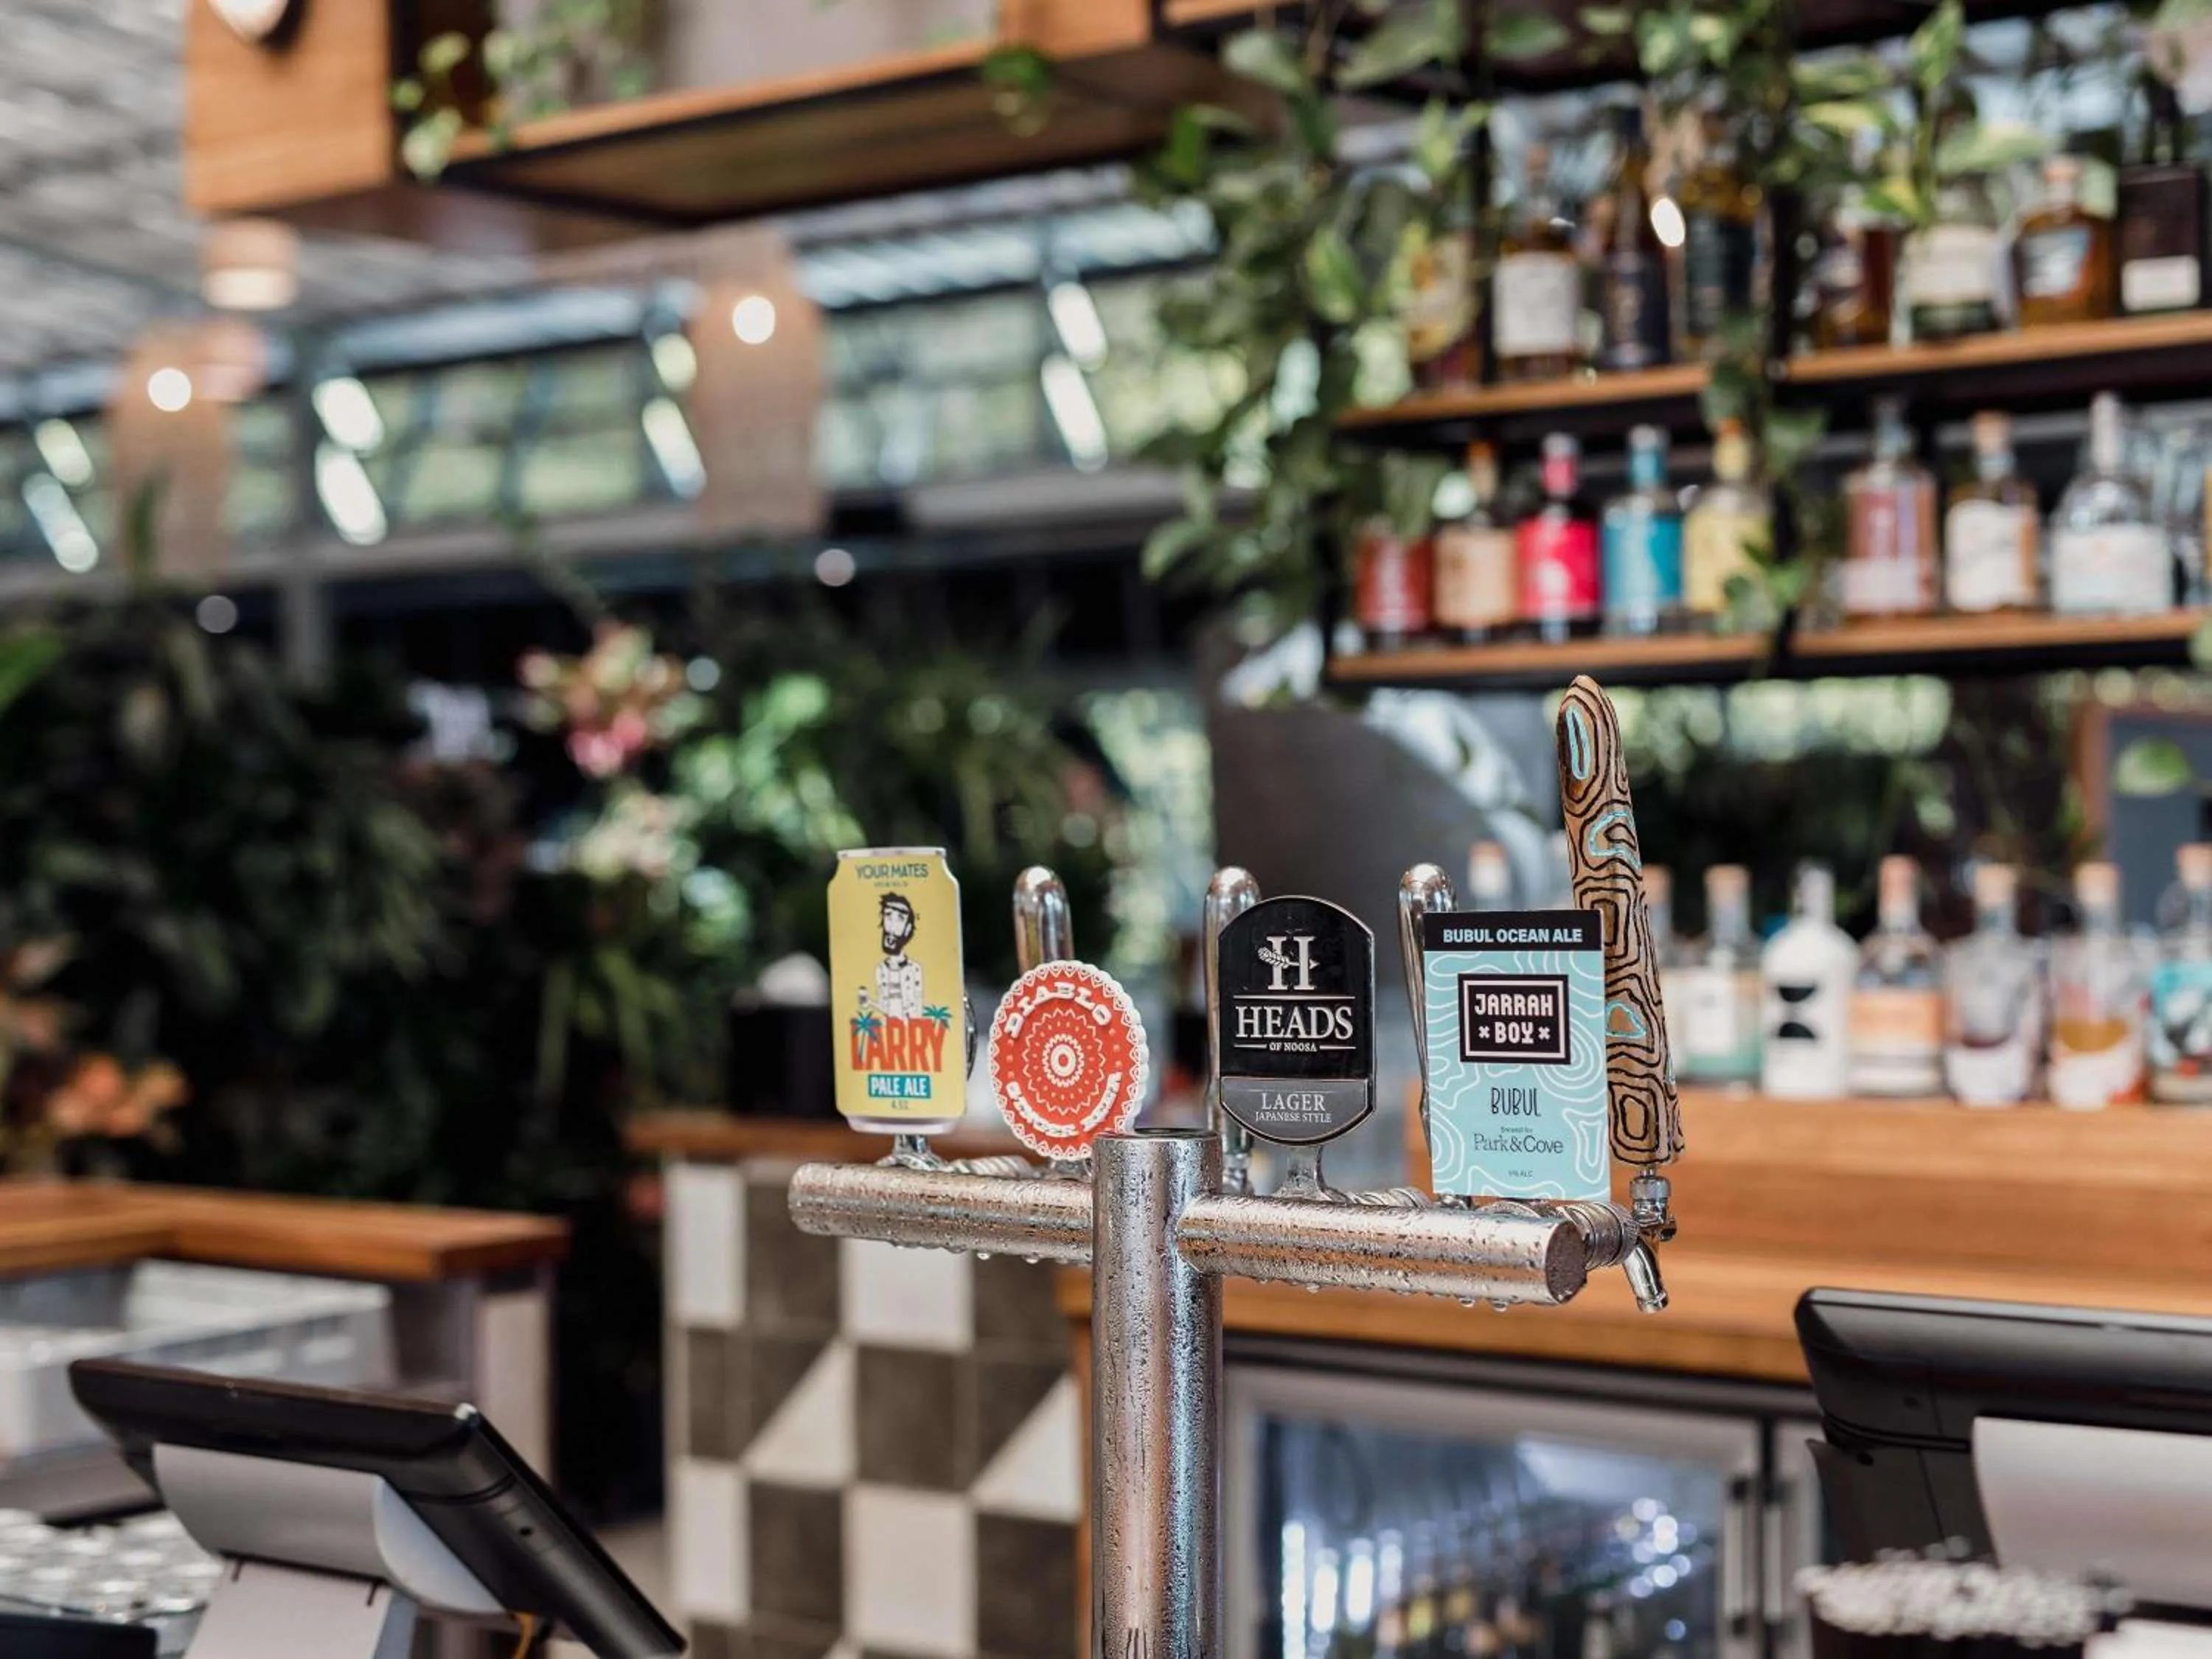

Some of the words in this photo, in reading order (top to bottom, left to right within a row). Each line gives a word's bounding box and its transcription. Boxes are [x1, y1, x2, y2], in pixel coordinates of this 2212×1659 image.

[855, 864, 889, 880] YOUR
[891, 863, 929, 879] MATES
[1443, 928, 1495, 943] BUBUL
[1496, 928, 1549, 944] OCEAN
[1552, 928, 1583, 943] ALE
[1004, 981, 1112, 1039] DIABLO
[1475, 993, 1554, 1016] JARRAH
[1235, 1006, 1354, 1040] HEADS
[1495, 1021, 1534, 1044] BOY
[850, 1015, 947, 1072] LARRY
[1269, 1043, 1282, 1051] OF
[1284, 1043, 1318, 1052] NOOSA
[871, 1077, 901, 1096] PALE
[904, 1077, 928, 1096] ALE
[1262, 1092, 1326, 1111] LAGER
[1491, 1086, 1542, 1117] BUBUL
[1256, 1111, 1301, 1121] JAPANESE
[1302, 1113, 1332, 1123] STYLE
